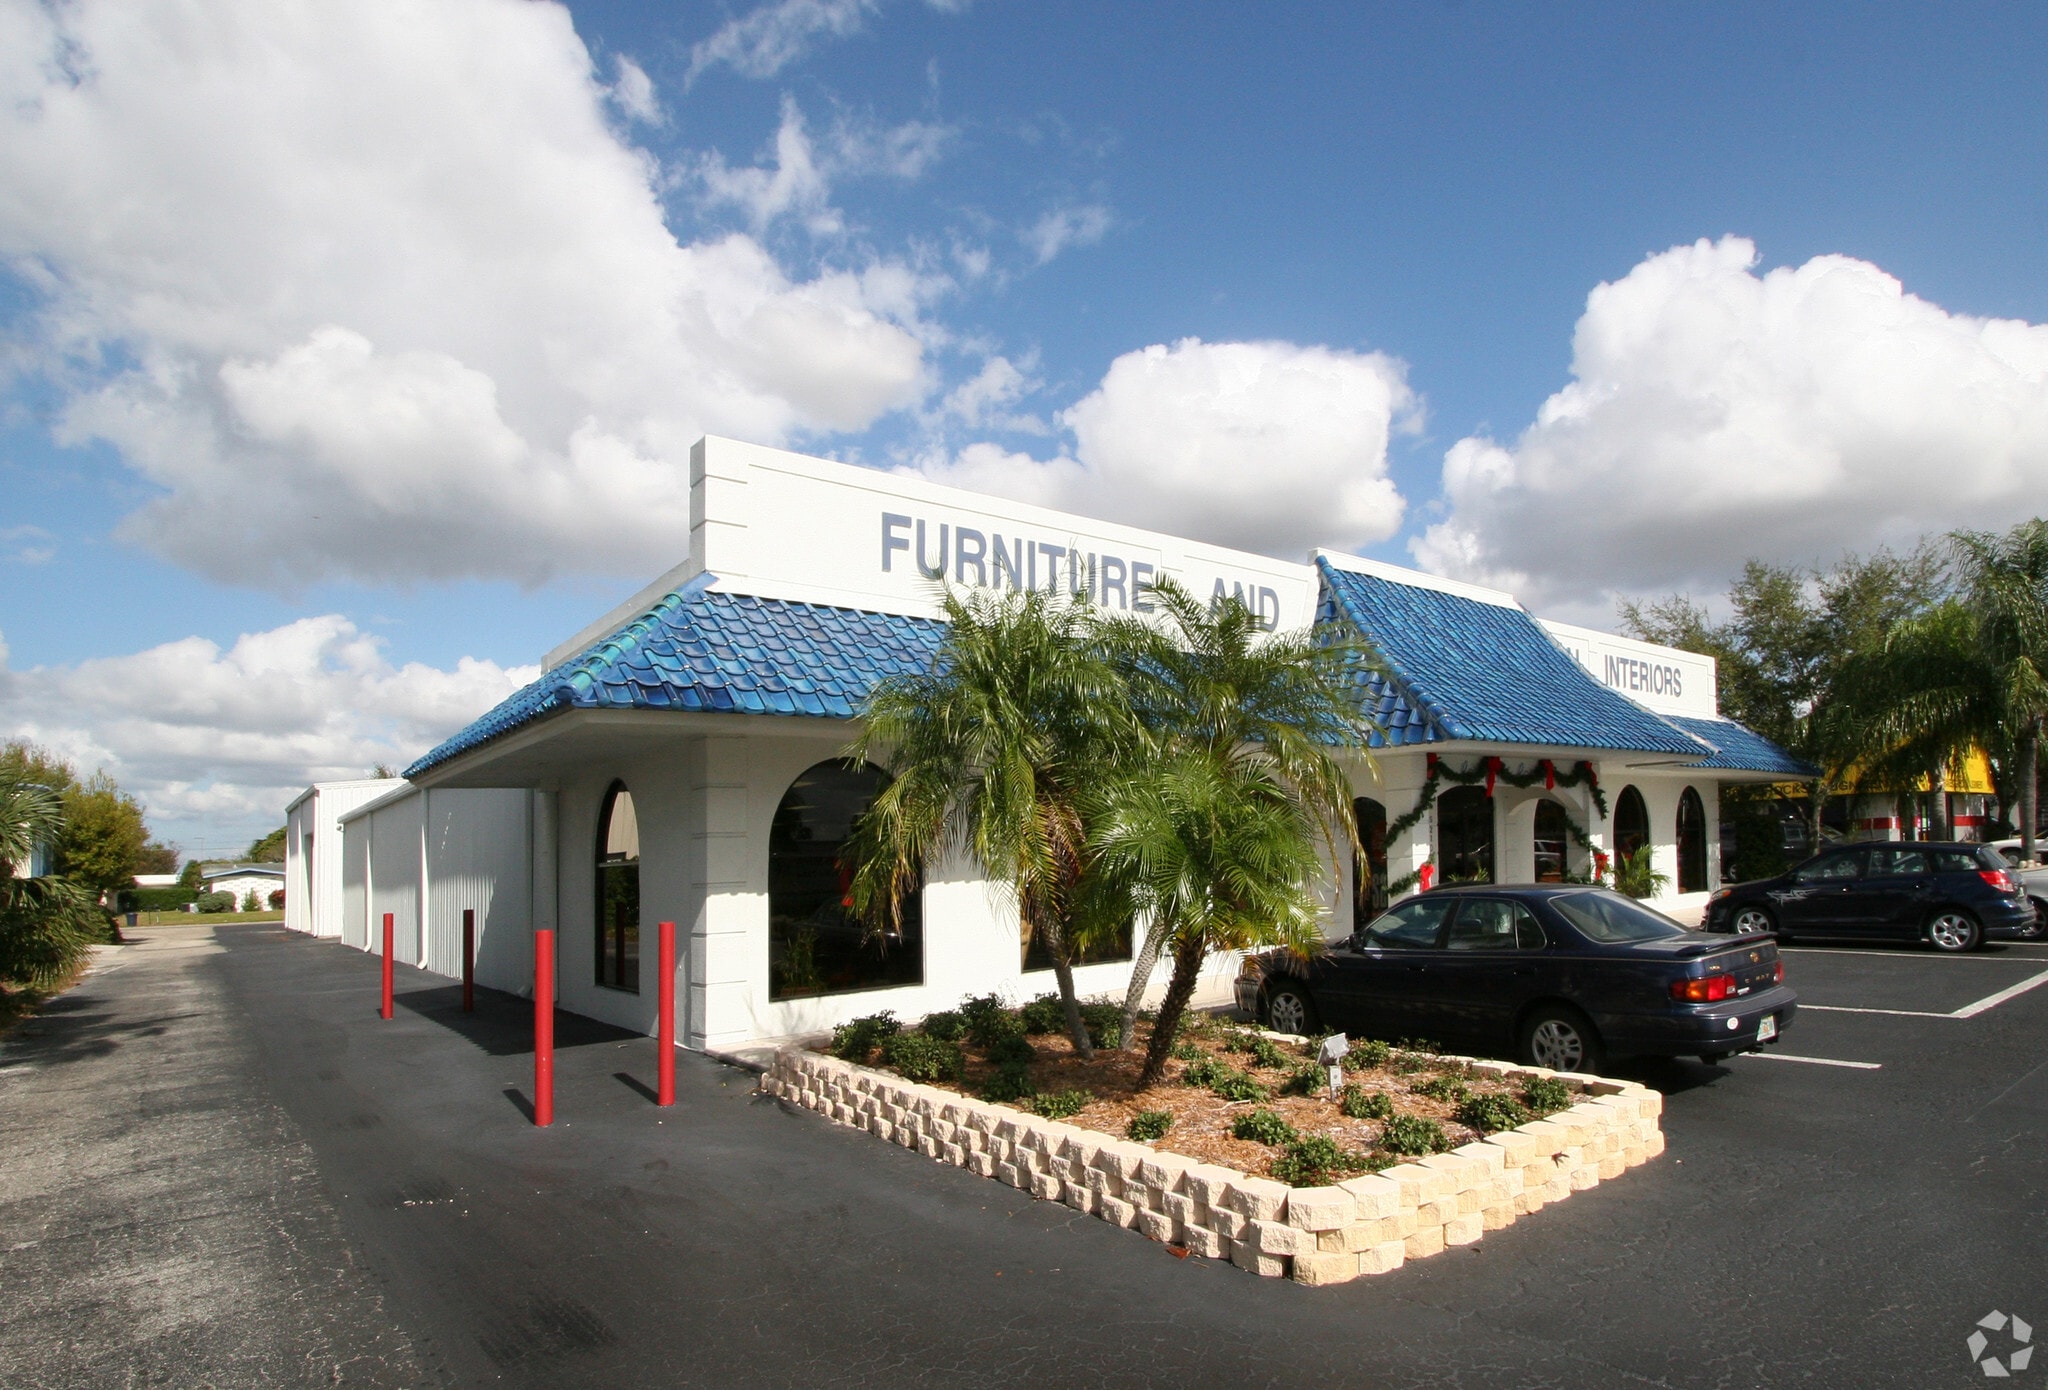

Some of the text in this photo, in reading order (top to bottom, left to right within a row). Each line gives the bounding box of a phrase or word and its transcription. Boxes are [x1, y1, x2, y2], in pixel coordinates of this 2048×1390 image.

[881, 511, 1280, 633] FURNITURE AND
[1604, 653, 1682, 698] INTERIORS
